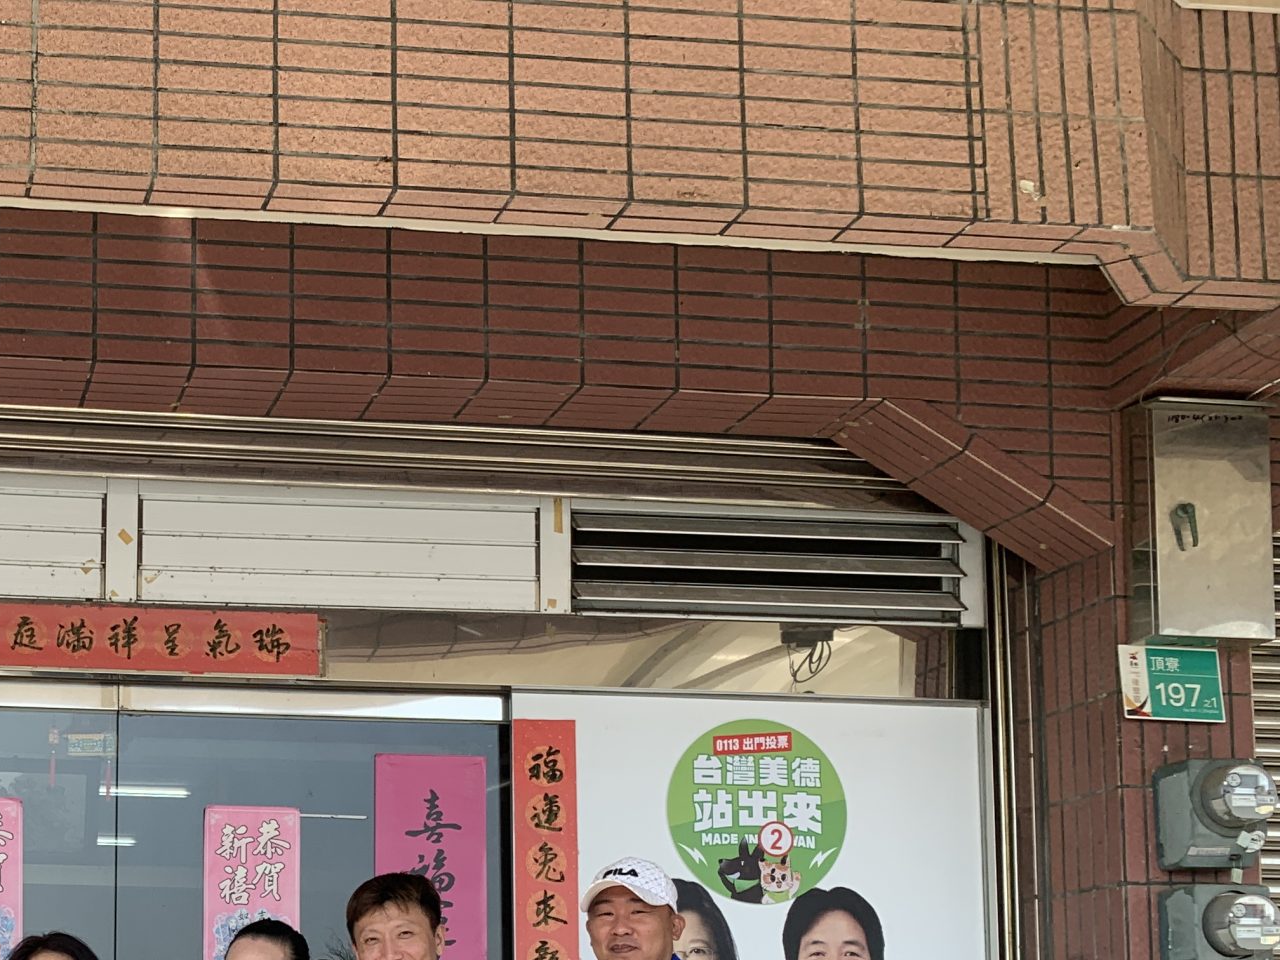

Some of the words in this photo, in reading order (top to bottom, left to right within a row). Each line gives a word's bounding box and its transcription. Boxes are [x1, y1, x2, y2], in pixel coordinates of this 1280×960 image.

[1149, 656, 1180, 672] 頂寮
[716, 739, 740, 751] 0113
[743, 736, 788, 750] 出門投票
[693, 754, 821, 788] 台灣美德
[693, 789, 822, 834] 站出來
[702, 833, 738, 846] MADE
[770, 829, 783, 850] 2
